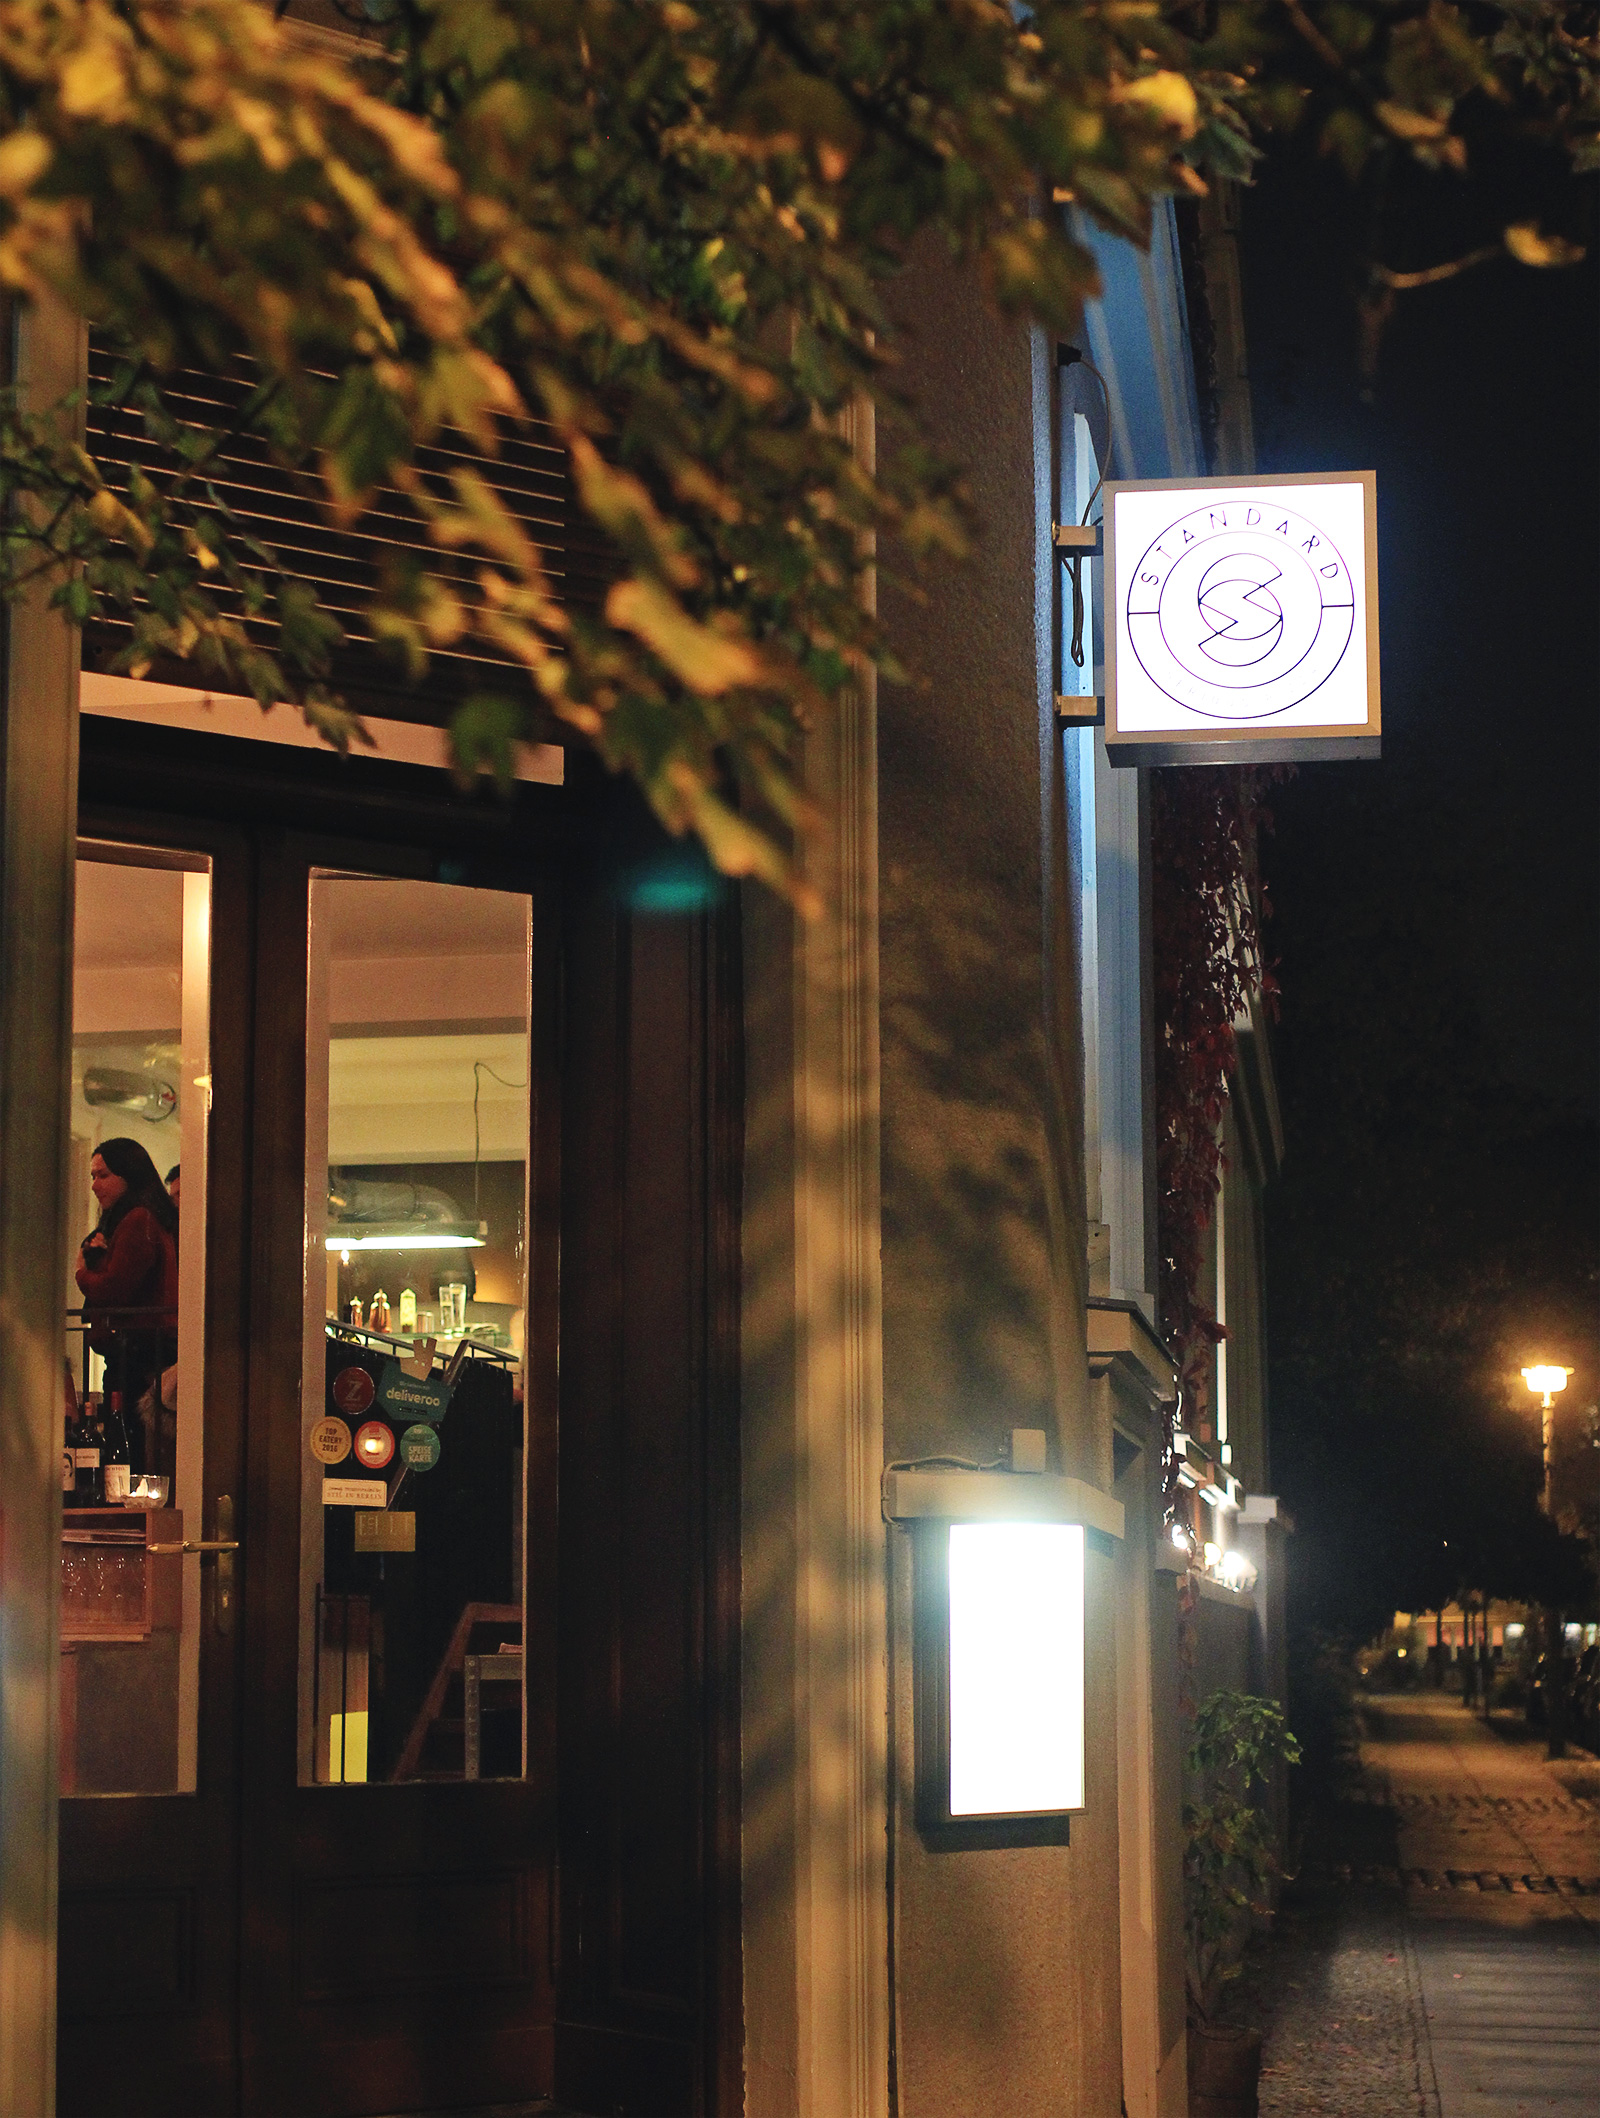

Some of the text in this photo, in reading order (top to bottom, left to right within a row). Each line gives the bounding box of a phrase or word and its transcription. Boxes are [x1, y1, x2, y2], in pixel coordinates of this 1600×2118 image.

[1141, 508, 1338, 586] STANDARD
[386, 1387, 441, 1407] deliveroo
[325, 1427, 338, 1435] TOP
[319, 1435, 343, 1444] EATERY
[322, 1443, 338, 1452] 2016
